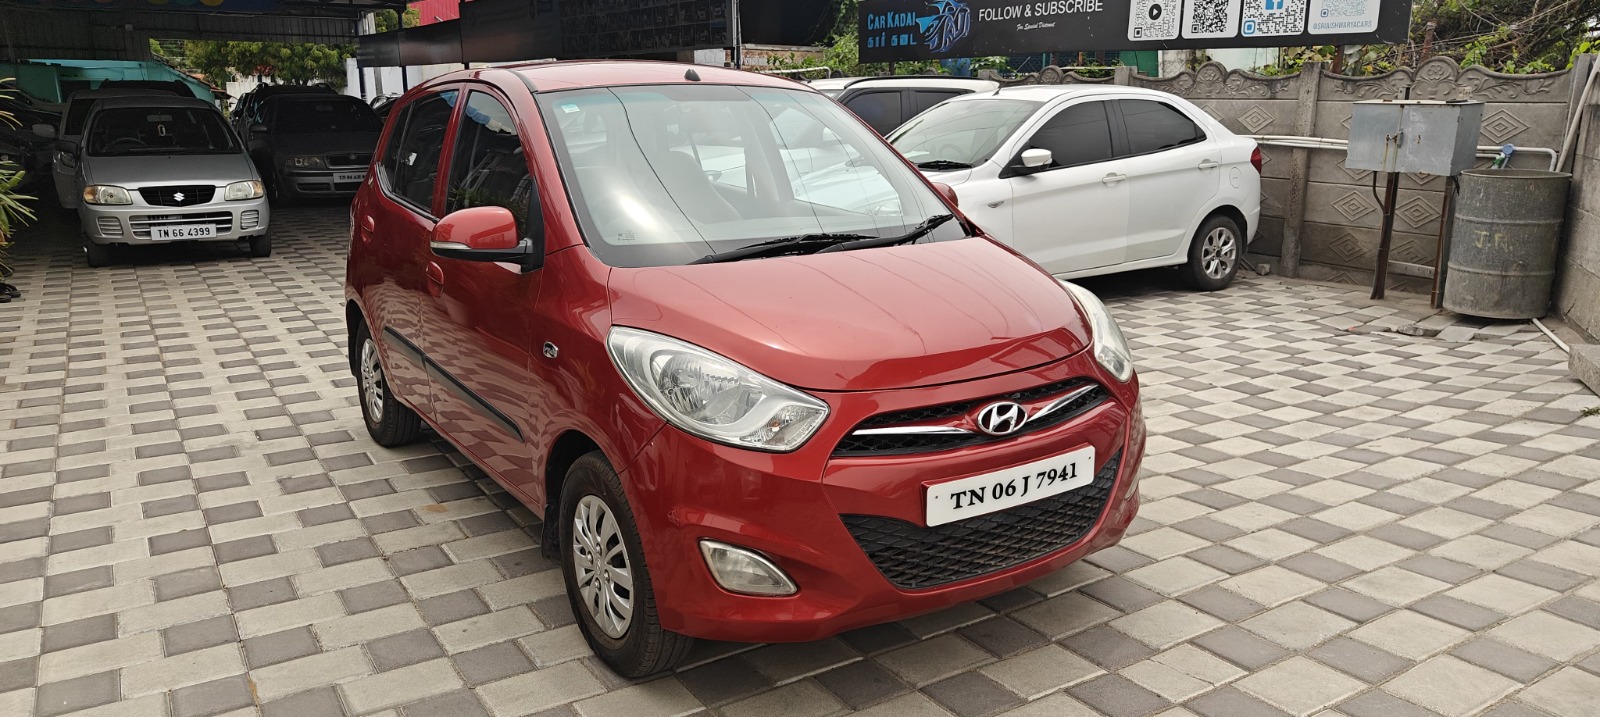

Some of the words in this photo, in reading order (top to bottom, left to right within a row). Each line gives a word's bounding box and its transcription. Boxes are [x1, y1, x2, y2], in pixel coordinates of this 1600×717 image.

[978, 5, 1022, 21] FOLLOW
[1024, 4, 1031, 17] &
[1034, 0, 1103, 16] SUBSCRIBE
[157, 229, 169, 238] TN
[172, 228, 184, 237] 66
[187, 227, 210, 237] 4399
[950, 486, 987, 509] TN
[992, 479, 1017, 500] 06
[1020, 475, 1031, 497] J
[1036, 462, 1078, 489] 7941
